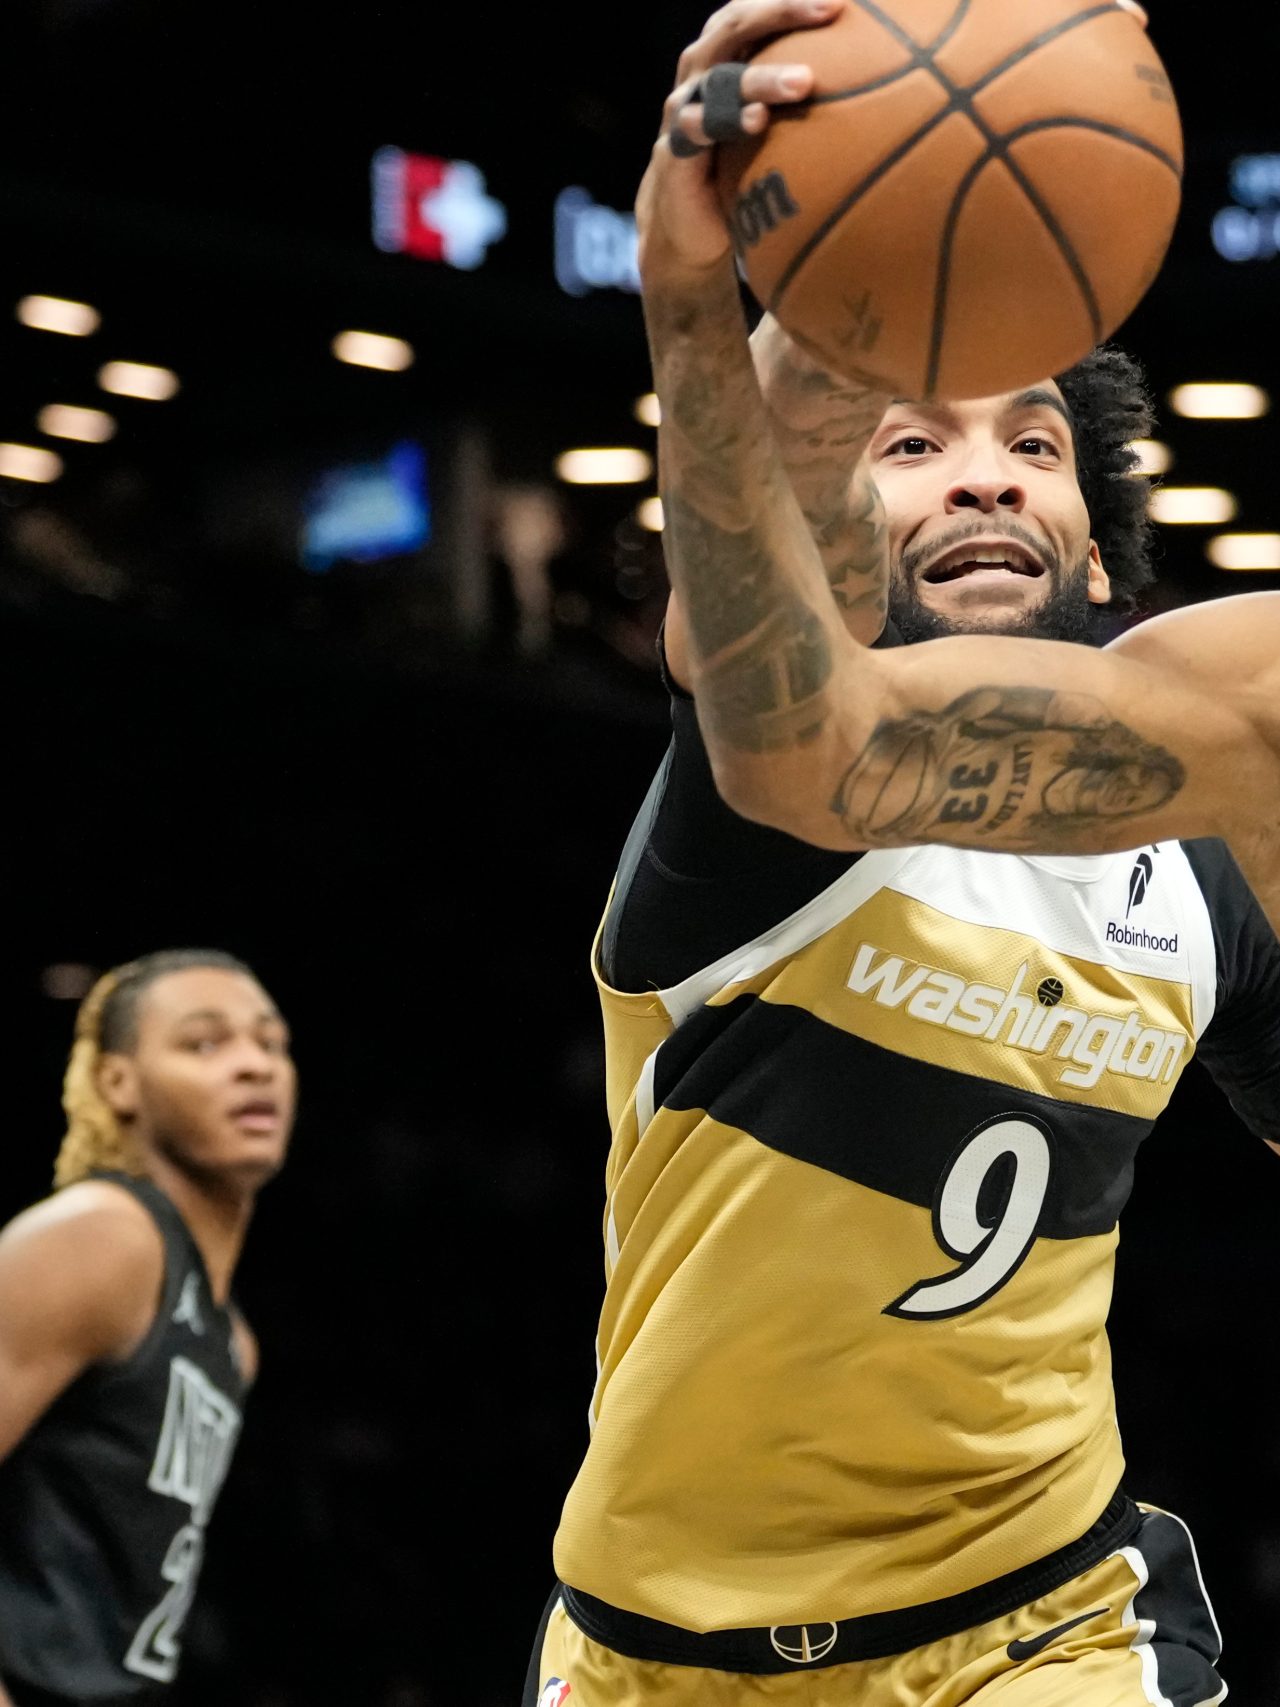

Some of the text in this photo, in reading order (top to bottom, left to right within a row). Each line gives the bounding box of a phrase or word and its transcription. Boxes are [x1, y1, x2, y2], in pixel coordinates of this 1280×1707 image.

[940, 761, 999, 823] 33
[1106, 922, 1178, 953] Robinhood
[845, 944, 1187, 1089] washington
[884, 1112, 1055, 1320] 9
